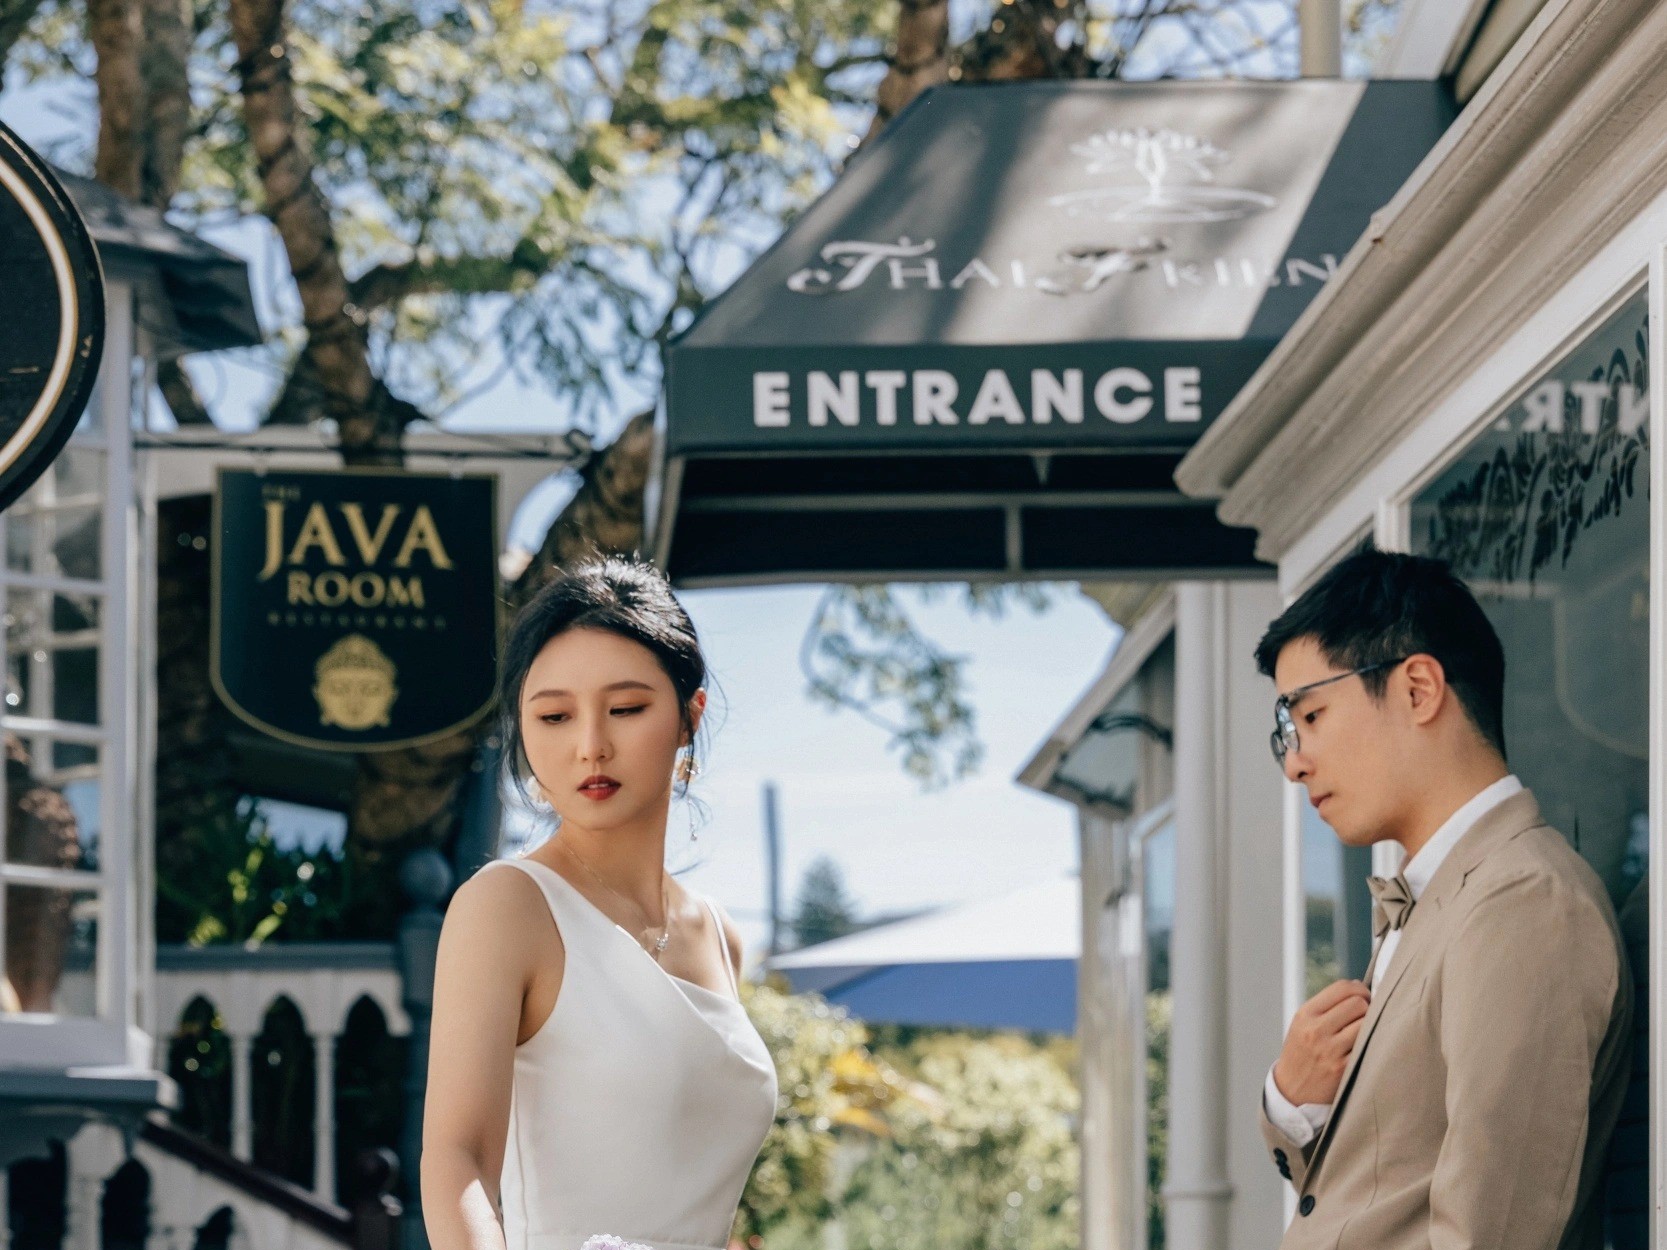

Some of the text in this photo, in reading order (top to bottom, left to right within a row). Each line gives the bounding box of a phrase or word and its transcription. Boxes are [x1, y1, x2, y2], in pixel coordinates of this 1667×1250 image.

[784, 236, 1025, 295] THAI
[754, 367, 1201, 427] ENTRANCE
[258, 501, 453, 580] JAVA
[287, 571, 425, 608] ROOM
